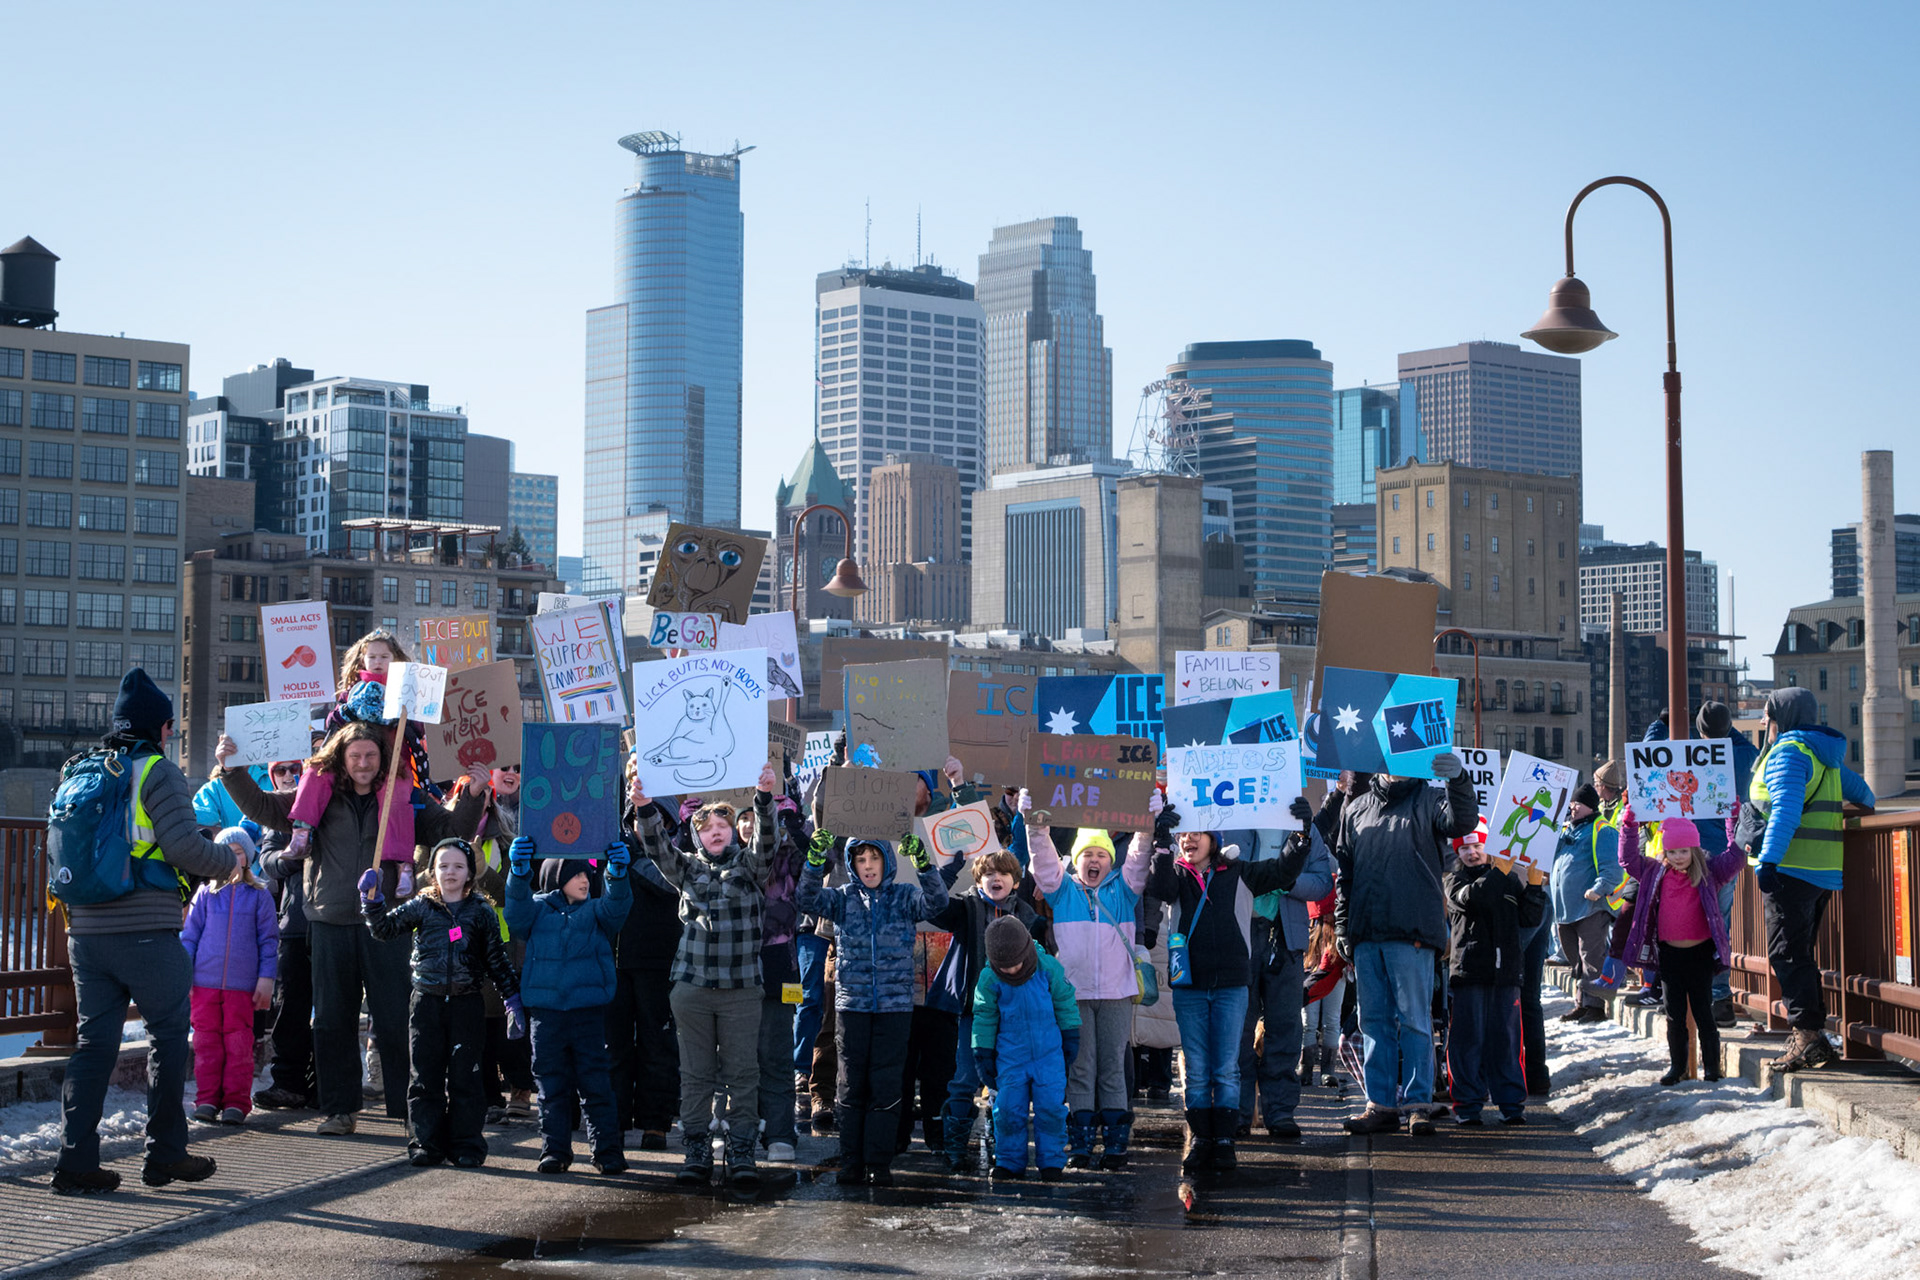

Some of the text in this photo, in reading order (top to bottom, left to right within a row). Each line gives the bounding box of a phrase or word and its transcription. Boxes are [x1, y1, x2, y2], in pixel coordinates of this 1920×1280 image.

[270, 613, 321, 625] SMALL ACTS
[286, 624, 318, 632] courage
[462, 619, 489, 639] OUT
[535, 615, 600, 646] WE
[650, 613, 679, 646] Be
[680, 613, 718, 650] Good
[540, 639, 606, 669] SUPPORT
[1184, 655, 1271, 674] FAMILIES
[283, 681, 320, 692] HOLD US
[546, 660, 616, 691] IMMIGRANTS
[638, 658, 766, 708] LICK BUTTS, NOT BOOTS
[1200, 676, 1253, 693] BELONG
[280, 690, 326, 700] TOGETHER
[1116, 676, 1163, 721] ICE
[1421, 701, 1447, 724] ICE
[251, 729, 279, 743] ICE
[1424, 722, 1448, 747] OUT
[541, 726, 616, 774] ICE
[1042, 741, 1112, 762] LEAVE
[1183, 747, 1286, 776] ADIOS
[1460, 748, 1488, 766] TO
[1632, 743, 1727, 769] NO ICE
[1040, 763, 1152, 781] THE CHILDREN
[1050, 782, 1101, 808] ARE
